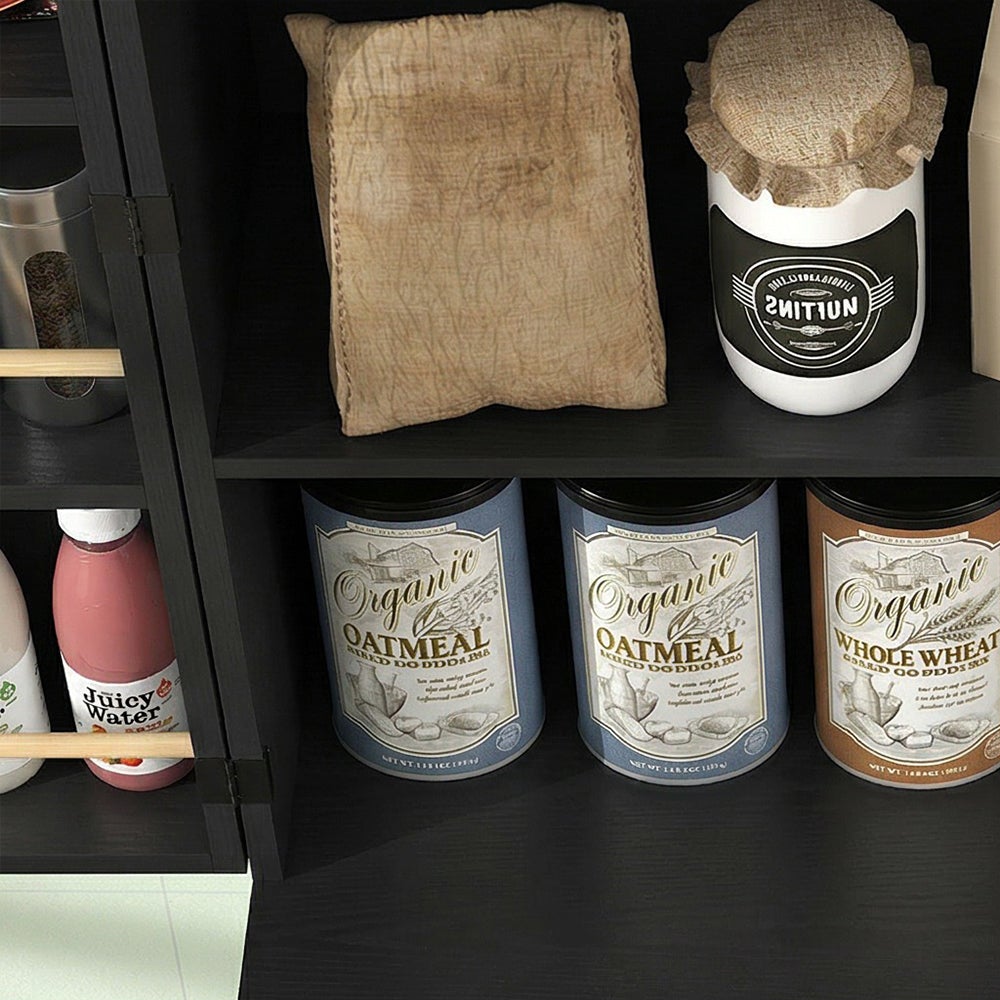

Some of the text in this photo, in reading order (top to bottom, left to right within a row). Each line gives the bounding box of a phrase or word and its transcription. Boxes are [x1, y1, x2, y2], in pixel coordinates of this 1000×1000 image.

[333, 547, 481, 632] Organic
[588, 549, 738, 638] Organic
[835, 554, 988, 641] Organic
[343, 623, 490, 660] OATMEAL
[596, 627, 744, 664] OATMEAL
[834, 627, 915, 667] WHOLE
[918, 628, 1000, 668] WHEAT
[83, 687, 155, 710] Juicy
[83, 700, 161, 725] Water
